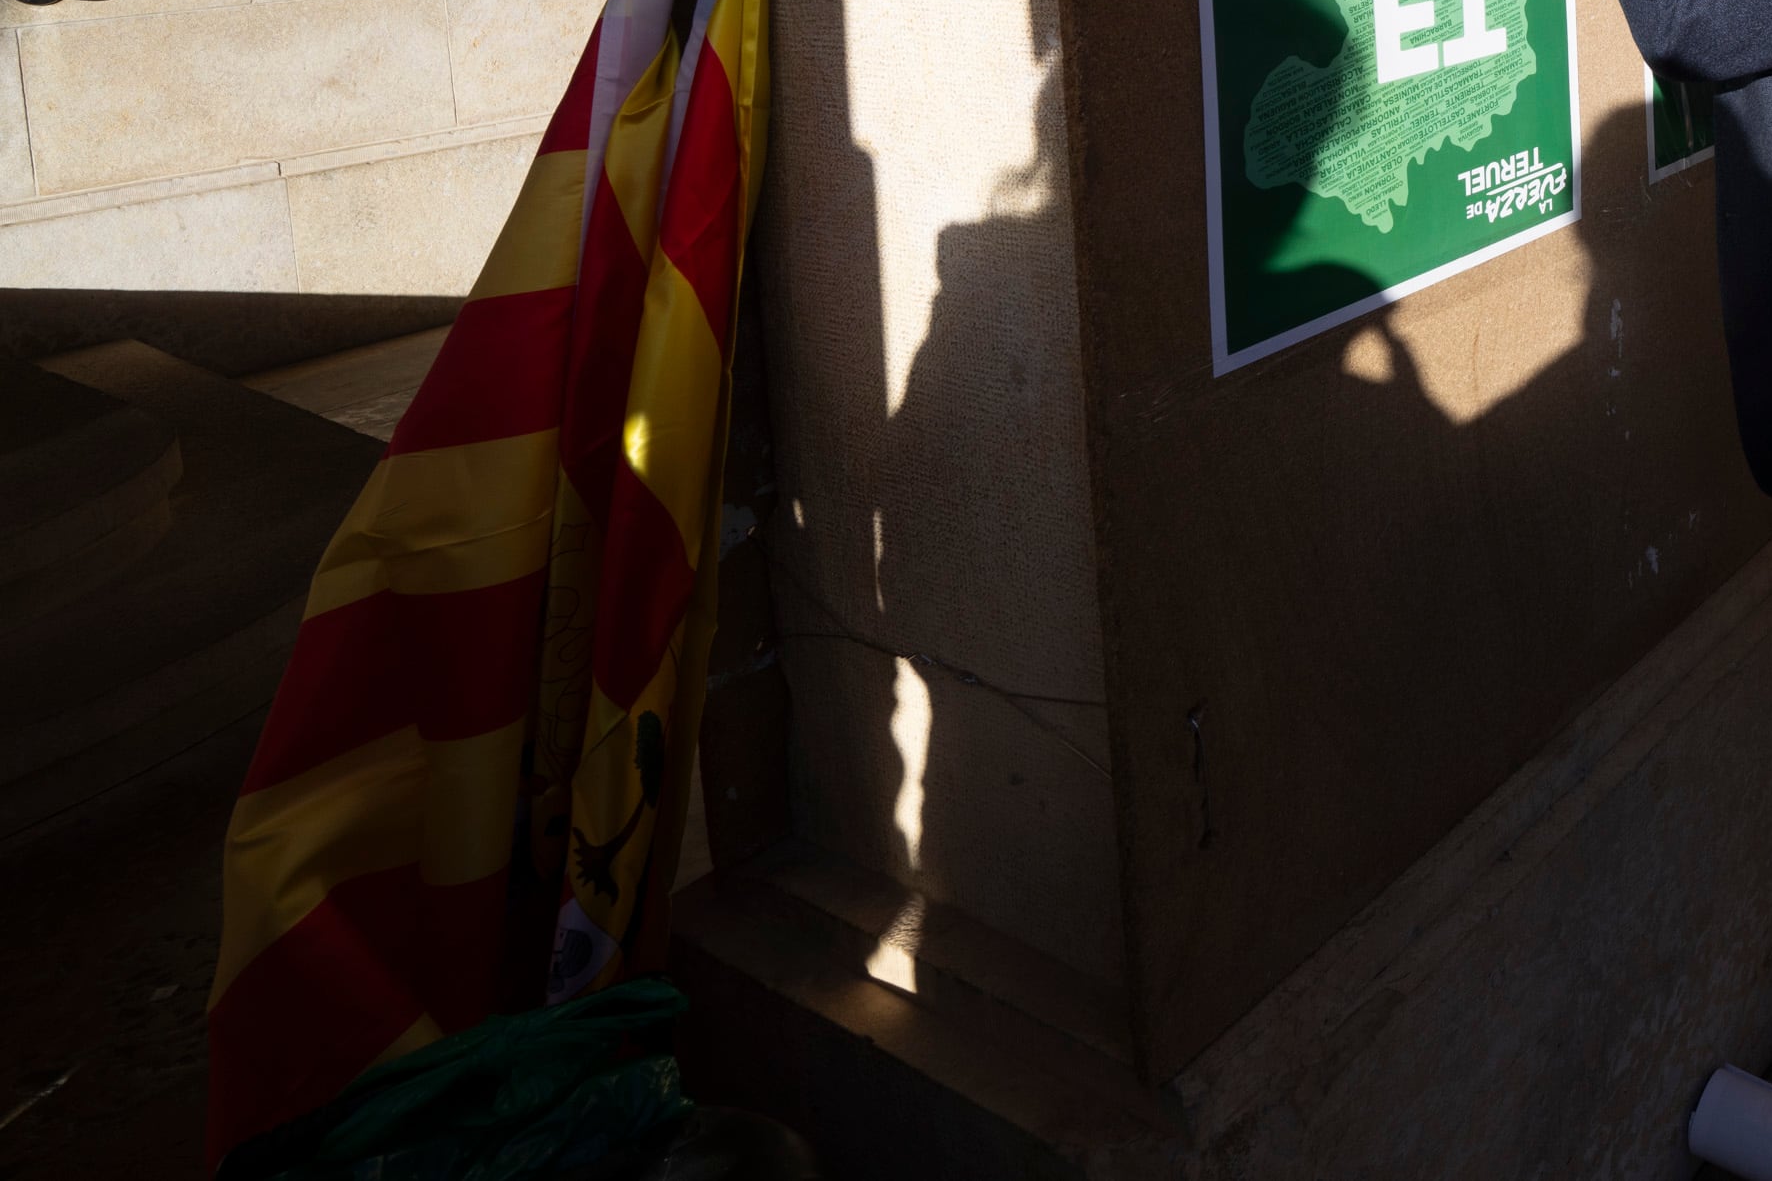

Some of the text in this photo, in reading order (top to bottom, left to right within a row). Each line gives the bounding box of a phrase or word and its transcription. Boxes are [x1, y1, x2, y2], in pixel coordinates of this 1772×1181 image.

[1349, 0, 1373, 14] CRETAS
[1410, 19, 1452, 44] BARRACHINA
[1383, 83, 1419, 107] MUNIESA
[1424, 70, 1483, 106] TRAMACASTILLA
[1445, 81, 1484, 108] TERRIENTE
[1360, 106, 1400, 131] ANDORRA
[1371, 112, 1410, 138] UTRILLAS
[1410, 109, 1439, 127] TERUEL
[1418, 108, 1465, 138] CASTELLOTE
[1458, 99, 1499, 127] FORTANETE
[1320, 148, 1366, 178] VILLASTAR
[1346, 146, 1398, 179] CANTAVIEJA
[1381, 156, 1402, 172] OLBA
[1458, 147, 1544, 196] TERUEL
[1466, 168, 1567, 223] FUERZA DE
[1538, 198, 1553, 214] LA
